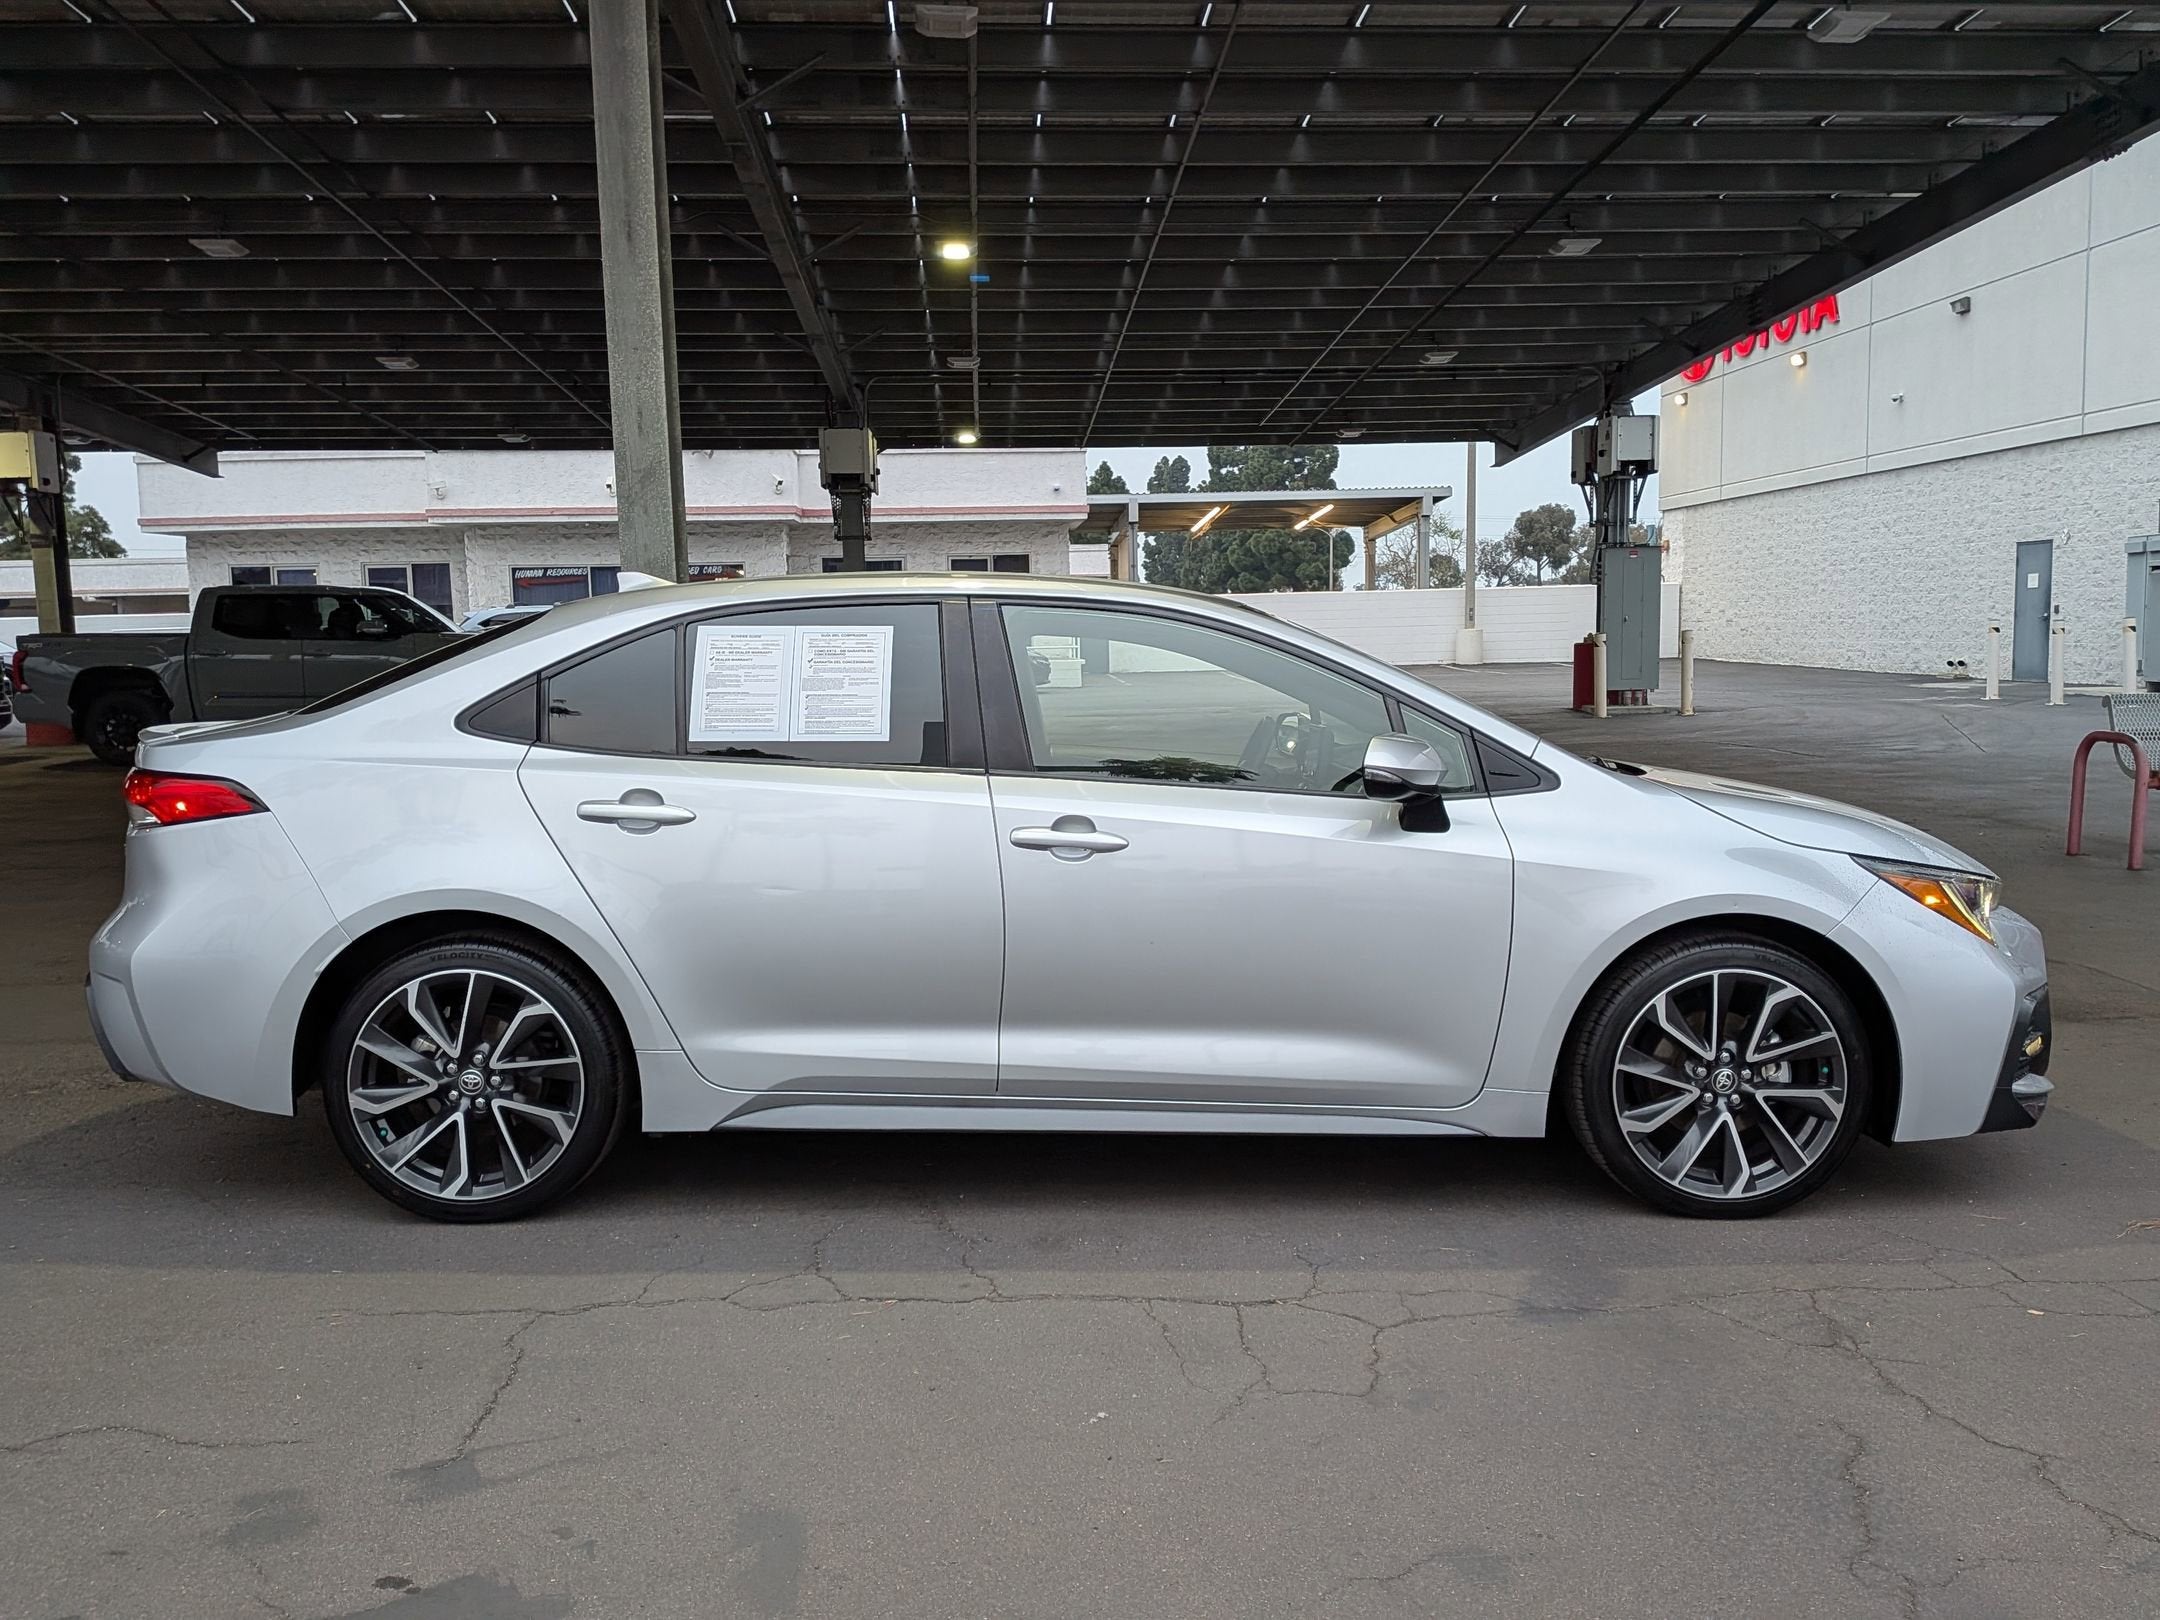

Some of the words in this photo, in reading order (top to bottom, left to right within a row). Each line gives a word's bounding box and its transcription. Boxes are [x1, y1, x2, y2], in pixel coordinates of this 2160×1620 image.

[514, 569, 544, 579] HUMAN
[546, 567, 588, 577] RESOURCES
[430, 951, 483, 961] VELOCITY
